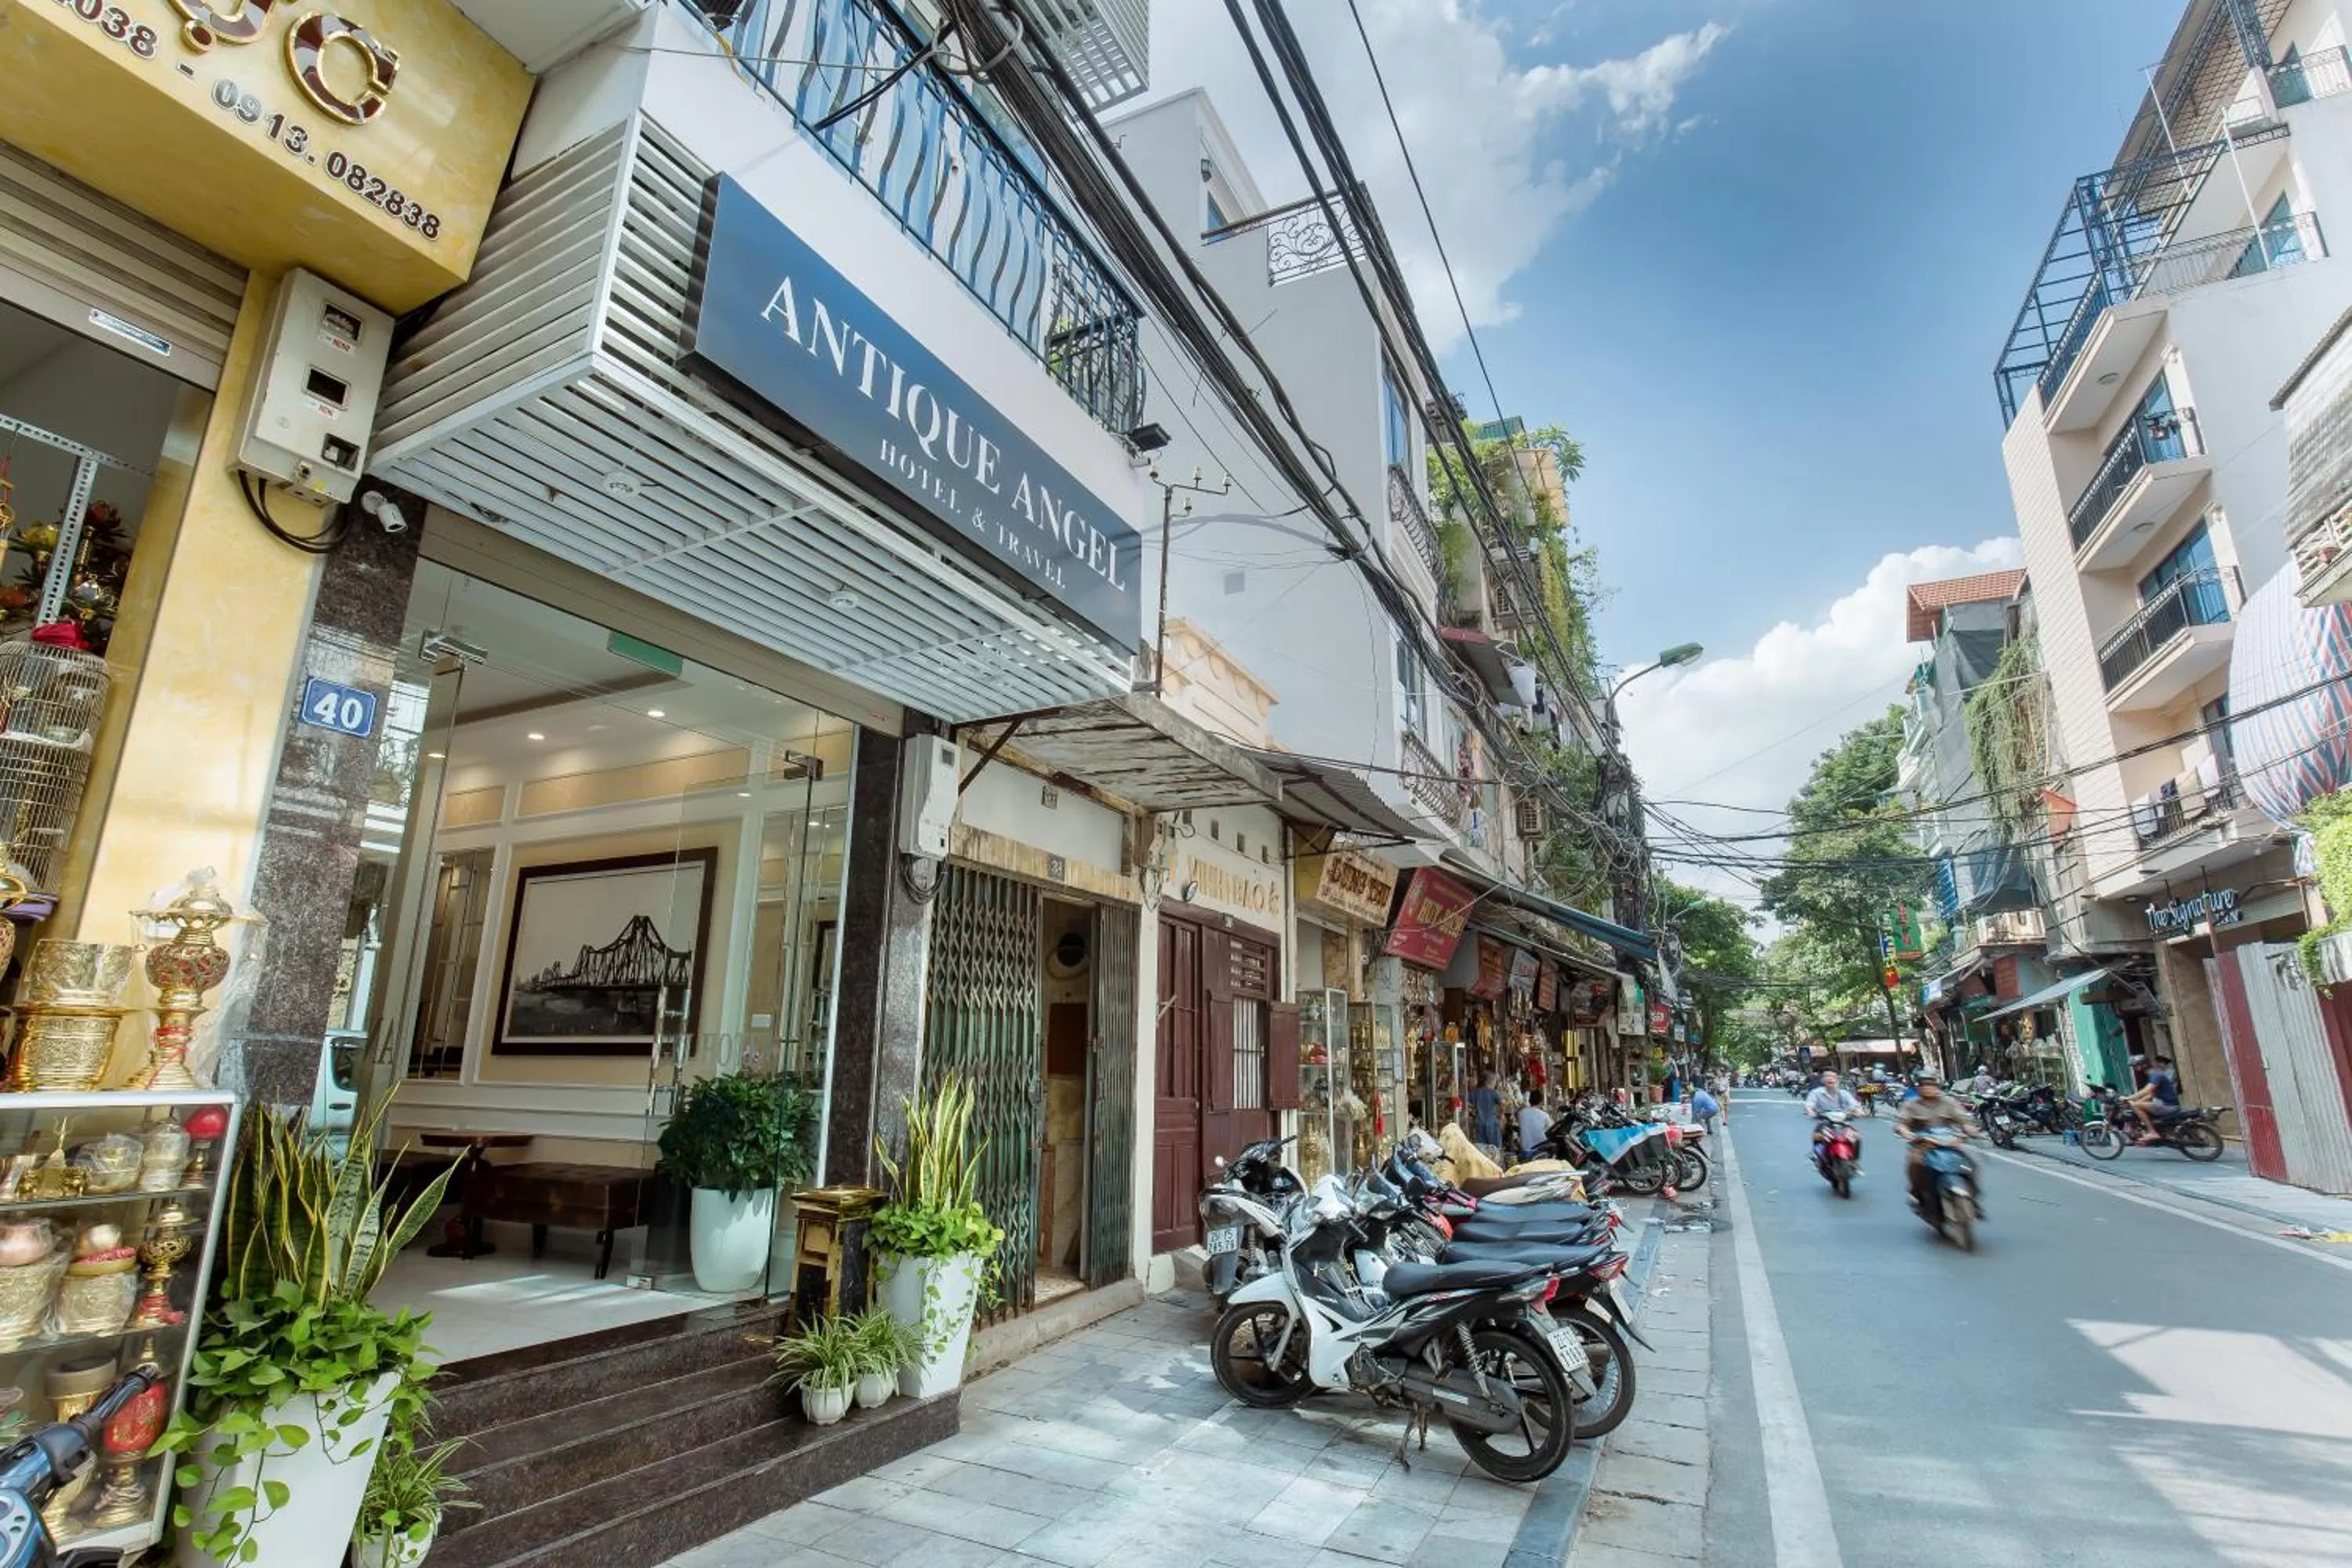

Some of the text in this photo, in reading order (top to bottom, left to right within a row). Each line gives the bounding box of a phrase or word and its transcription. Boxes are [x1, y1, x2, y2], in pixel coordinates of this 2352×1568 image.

[760, 274, 1126, 591] ANTIQUE ANGEL
[879, 437, 1066, 590] HOTEL & TRAVEL
[314, 692, 363, 729] 40
